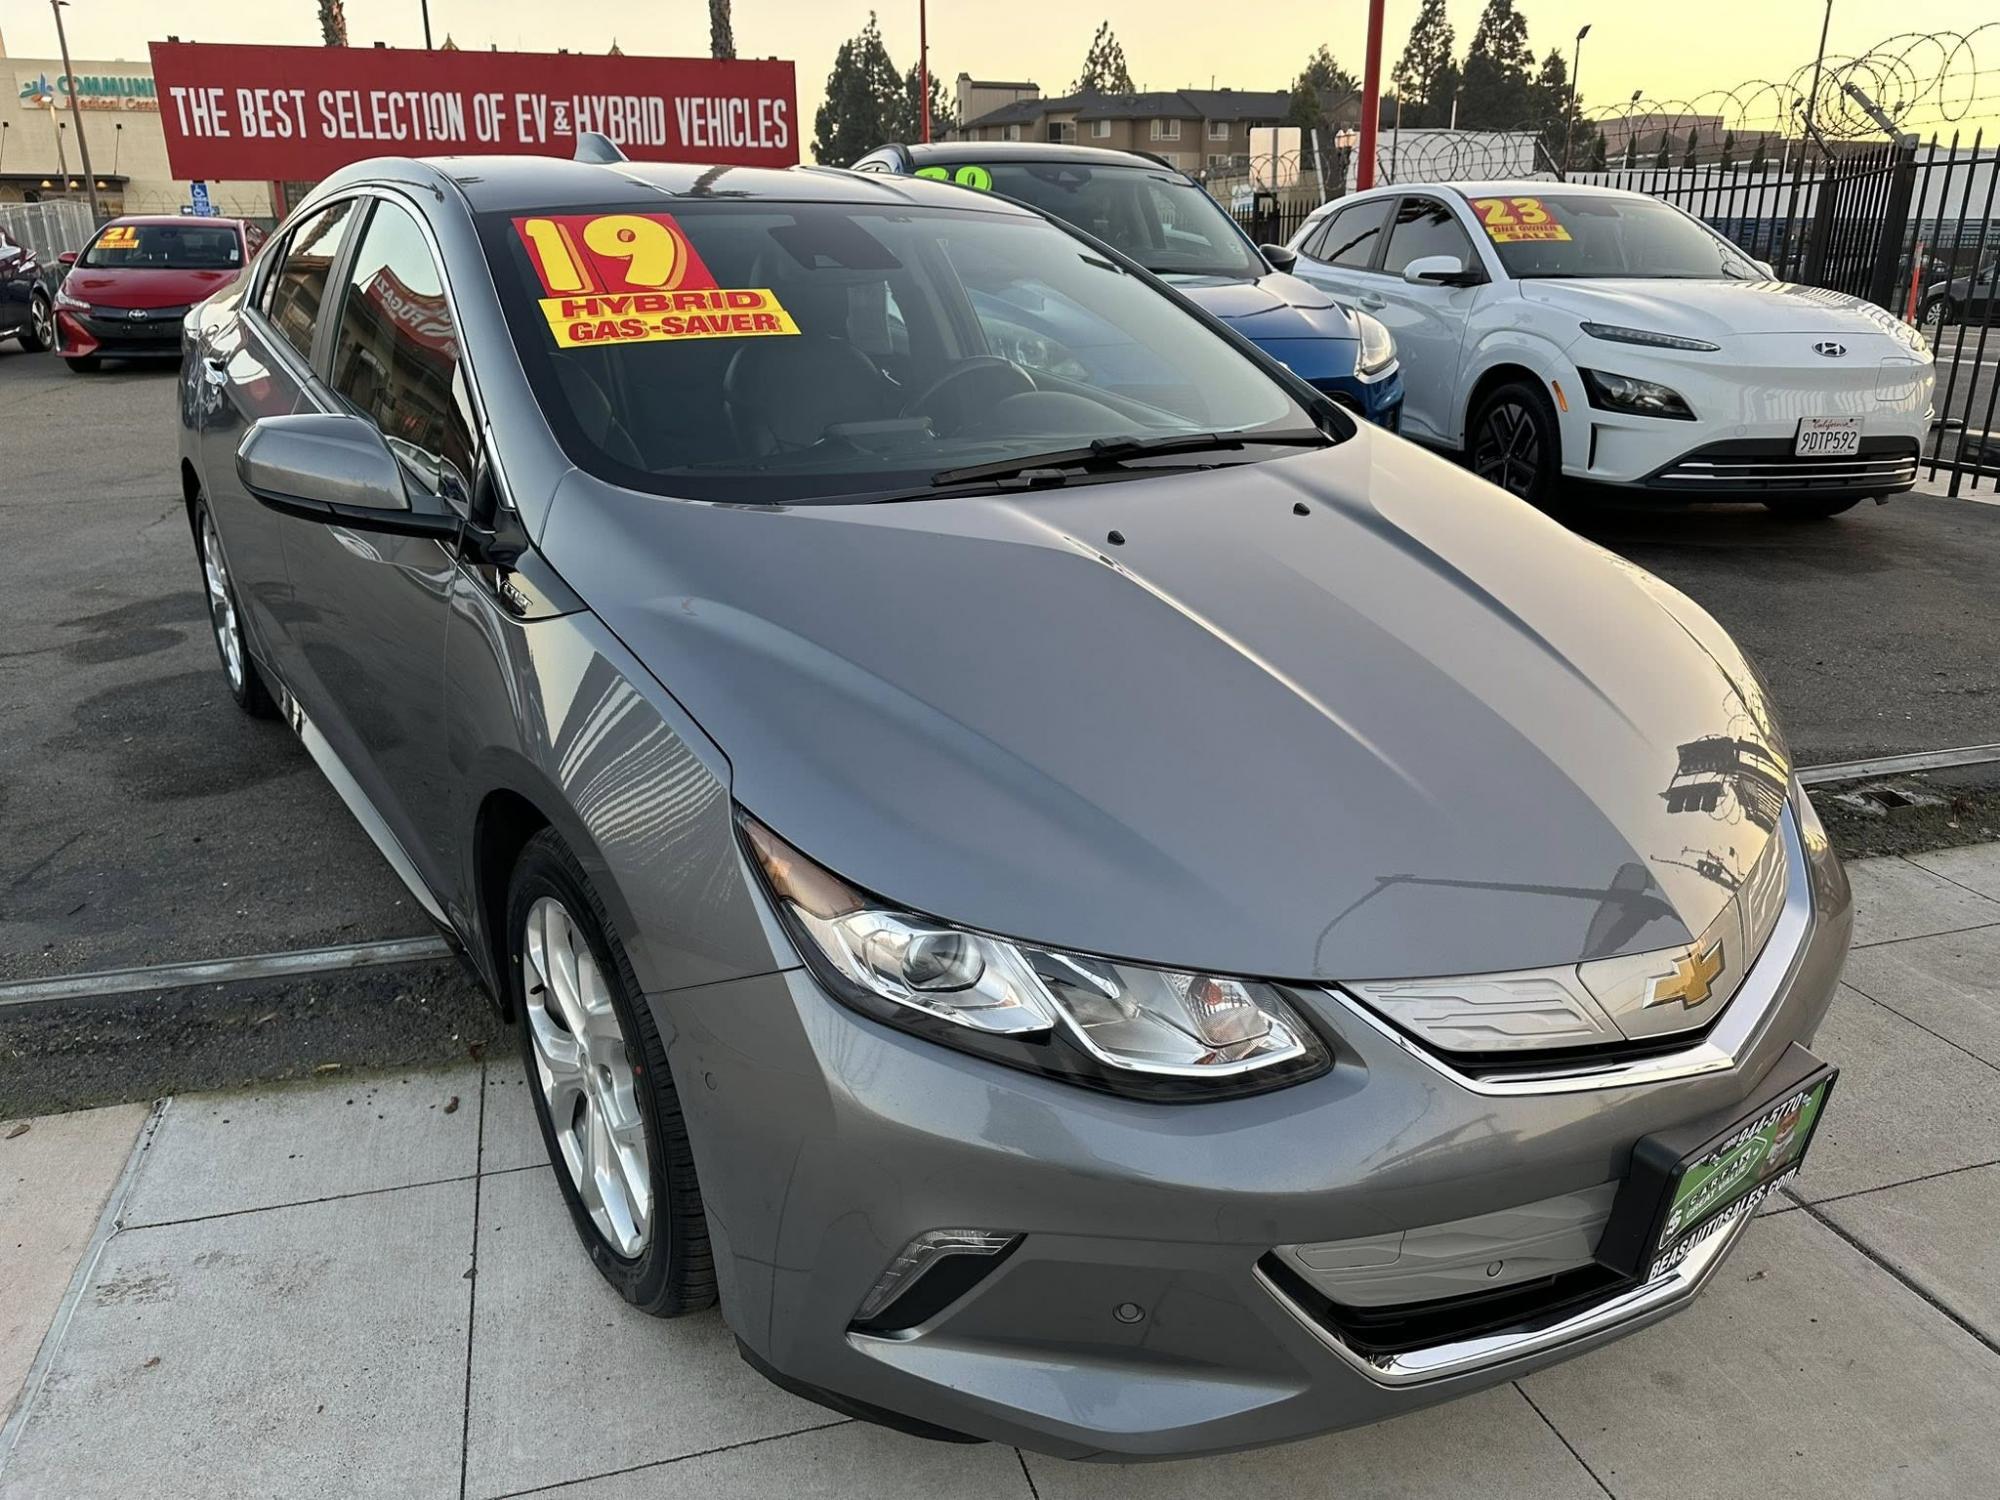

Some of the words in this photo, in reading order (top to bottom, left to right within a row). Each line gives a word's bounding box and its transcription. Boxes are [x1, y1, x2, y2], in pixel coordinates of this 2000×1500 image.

[169, 87, 230, 137] THE
[236, 88, 307, 138] BEST
[317, 89, 466, 142] SELECTION
[473, 93, 506, 142] OF
[515, 94, 547, 143] EV
[573, 94, 666, 146] HYBRID
[675, 96, 788, 149] VEHICLES
[1474, 197, 1551, 225] 23
[103, 226, 136, 240] 21
[524, 214, 687, 292] 19
[561, 291, 767, 319] HYBRID
[567, 313, 782, 343] GAS-SAVER
[1801, 431, 1857, 451] 9DTP592
[1736, 1091, 1804, 1148] 944-5770
[1650, 1166, 1798, 1278] BEASAUTOSALES.com
